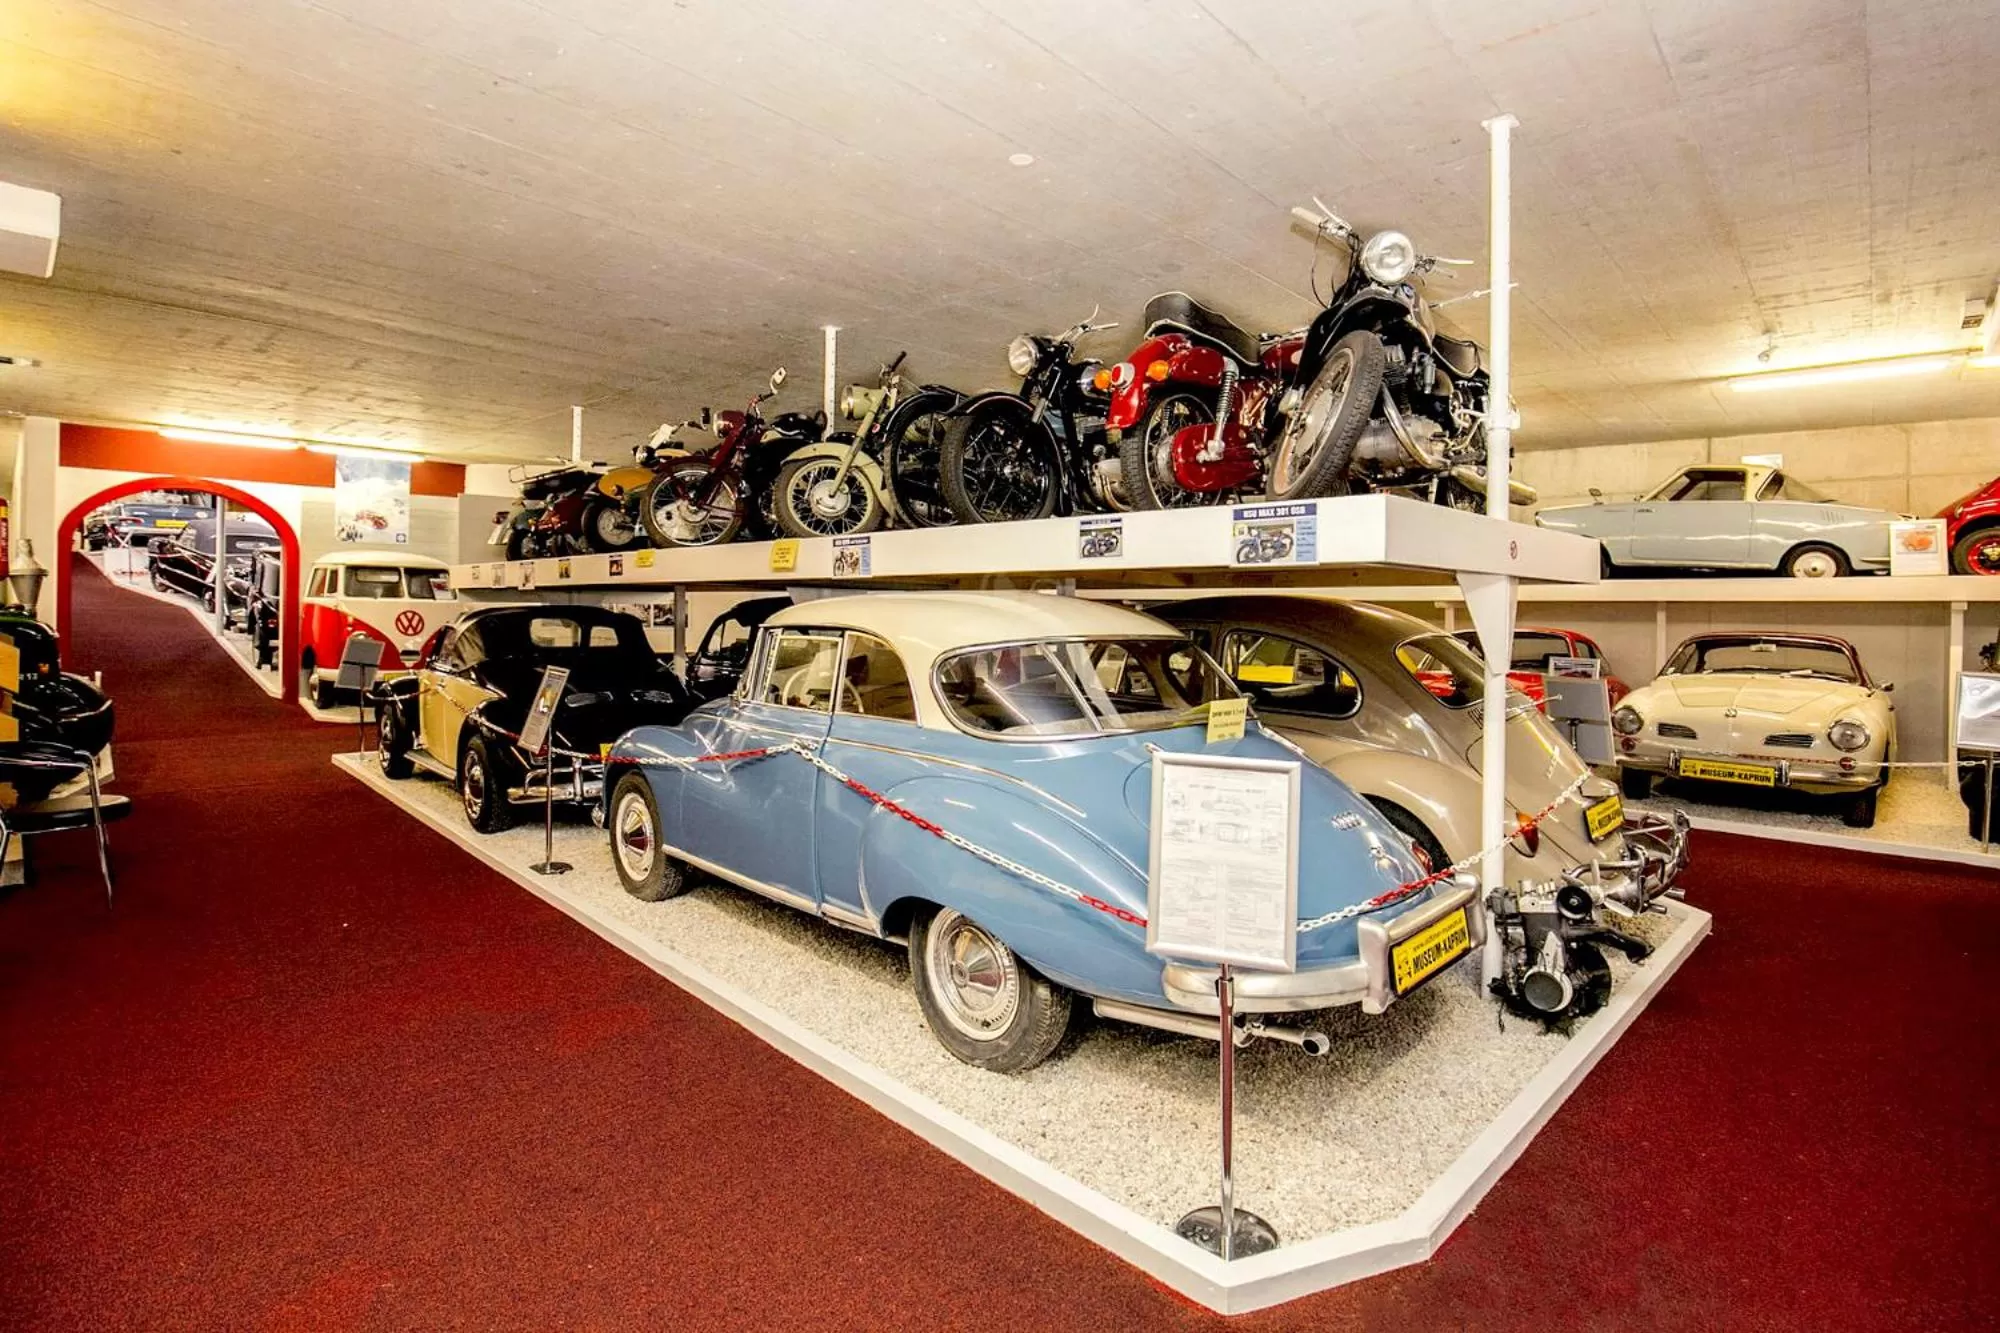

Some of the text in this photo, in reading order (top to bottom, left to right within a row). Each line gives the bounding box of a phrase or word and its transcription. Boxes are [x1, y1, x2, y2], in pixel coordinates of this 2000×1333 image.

[1259, 508, 1275, 517] MAX
[1699, 767, 1771, 783] MUSEUM-KAPRUN
[1412, 926, 1468, 975] MUSEUM-KAPRUN
